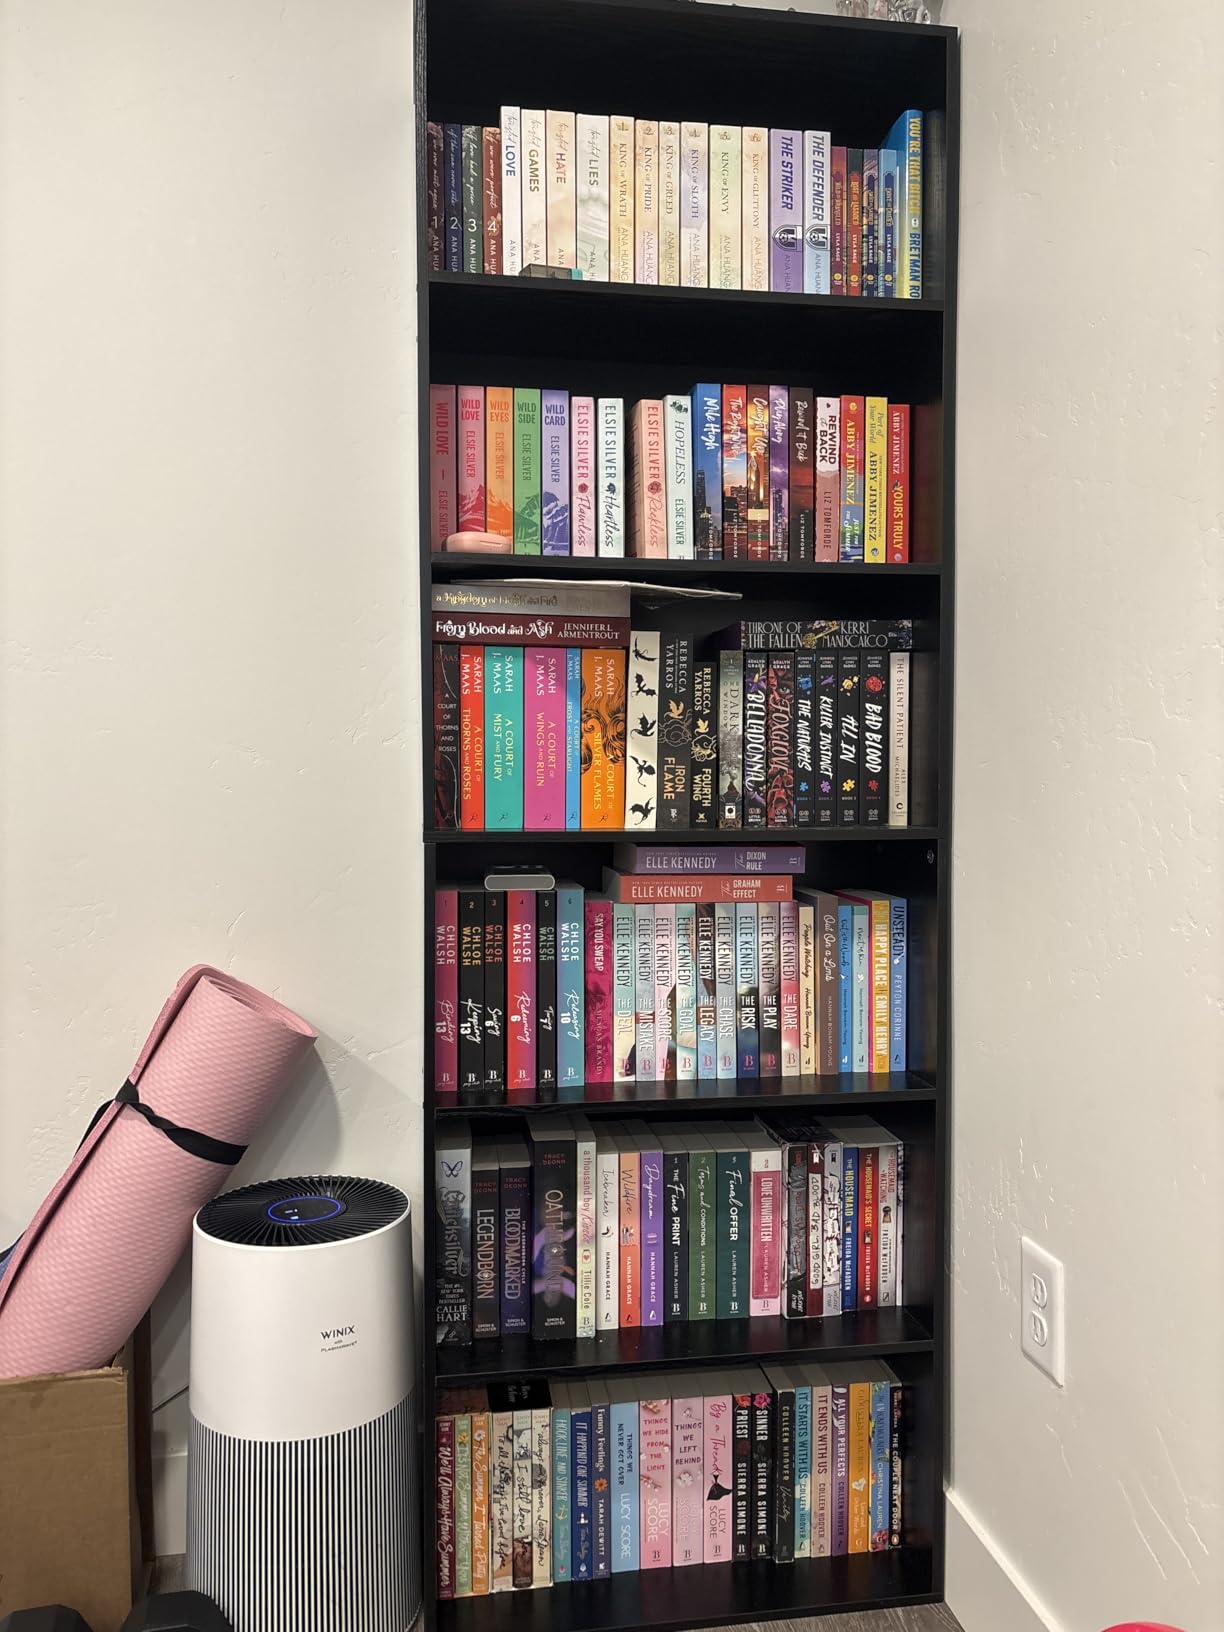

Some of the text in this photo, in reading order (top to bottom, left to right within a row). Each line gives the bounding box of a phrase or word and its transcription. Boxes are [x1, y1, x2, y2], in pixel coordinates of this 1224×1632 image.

[909, 117, 920, 153] YOU'RE
[506, 145, 515, 176] LOVE
[529, 149, 539, 192] GAMES
[556, 152, 565, 183] HATE
[589, 159, 598, 185] LIES
[781, 136, 792, 210] THE STRIKER
[909, 157, 920, 180] THAT
[813, 136, 824, 221] THE DEFENDER
[432, 217, 439, 228] 1
[450, 217, 458, 229] 2
[468, 220, 476, 232] 3
[488, 220, 497, 232] 4
[909, 233, 920, 281] BRETMAN
[461, 400, 480, 410] WILD
[461, 411, 480, 421] LOVE
[518, 402, 536, 412] WILD
[518, 413, 536, 424] SIDE
[545, 405, 564, 414] WILD
[545, 416, 565, 425] CARD
[675, 421, 685, 484] HOPELESS
[819, 431, 828, 462] BACK
[828, 416, 837, 465] REWIND
[522, 434, 531, 481] ELSIE SILVER
[576, 405, 591, 546] ELSIE SILVER Flawless
[605, 406, 617, 547] ELSIE SILVER Heartless
[647, 407, 661, 547] ELSIE SILVER Reckless
[869, 452, 878, 541] ABBY JIMENEZ
[436, 620, 554, 638] From Blood and Ash
[557, 631, 620, 639] ARMENTROUT
[565, 623, 605, 631] JENNIFER
[748, 622, 801, 636] THRONE OF
[823, 635, 887, 647] MANISCALCO
[840, 623, 869, 634] KERRI
[748, 636, 802, 648] THE FALLEN
[895, 658, 904, 748] THE SILENT PATIENT
[505, 719, 511, 727] A
[772, 698, 791, 775] FOXGLOVE
[505, 730, 513, 766] COURT
[747, 691, 765, 792] BELLADONNA
[865, 703, 882, 773] BAD BLOOD
[664, 757, 674, 800] FLAME
[677, 765, 685, 792] IRON
[693, 775, 702, 800] WING
[702, 768, 711, 806] FOURTH
[646, 857, 717, 872] ELLE KENNEDY
[747, 852, 766, 860] DIXON
[747, 862, 762, 870] RULE
[632, 886, 703, 902] ELLE KENNEDY
[733, 880, 761, 888] GRAHAM
[733, 890, 756, 898] EFFECT
[513, 924, 521, 962] WALSH
[523, 924, 531, 962] CHLOE
[561, 923, 569, 961] WALSH
[571, 923, 579, 961] CHLOE
[740, 916, 752, 985] ELLE KENNEDY
[875, 925, 886, 987] HAPPY PLACE
[700, 996, 713, 1005] THE
[741, 995, 755, 1005] THE
[763, 995, 776, 1005] THE
[460, 1023, 468, 1034] 13
[461, 998, 482, 1044] Keeping
[561, 1013, 569, 1023] 10
[700, 1008, 714, 1042] LEGACY
[742, 1008, 755, 1029] RISK
[764, 1008, 776, 1029] PLAY
[876, 995, 887, 1055] EMILY HENRY
[667, 1182, 685, 1215] Fine
[726, 1169, 742, 1206] Final
[845, 1170, 854, 1216] HOUSEMAID
[671, 1217, 680, 1246] PRINT
[730, 1208, 738, 1240] OFFER
[505, 1208, 520, 1299] BLOODMARKED
[436, 1305, 467, 1313] CALLIE
[437, 1313, 467, 1322] HART
[321, 1325, 355, 1339] WINIX
[737, 1410, 747, 1438] PRIEST
[757, 1410, 768, 1440] SINNER
[799, 1403, 808, 1439] STARTS
[676, 1457, 700, 1465] BEHIND
[799, 1441, 808, 1468] WITH
[799, 1470, 808, 1479] US
[737, 1463, 746, 1535] SIERRA SIMONE
[621, 1493, 630, 1559] LUCY SCORE
